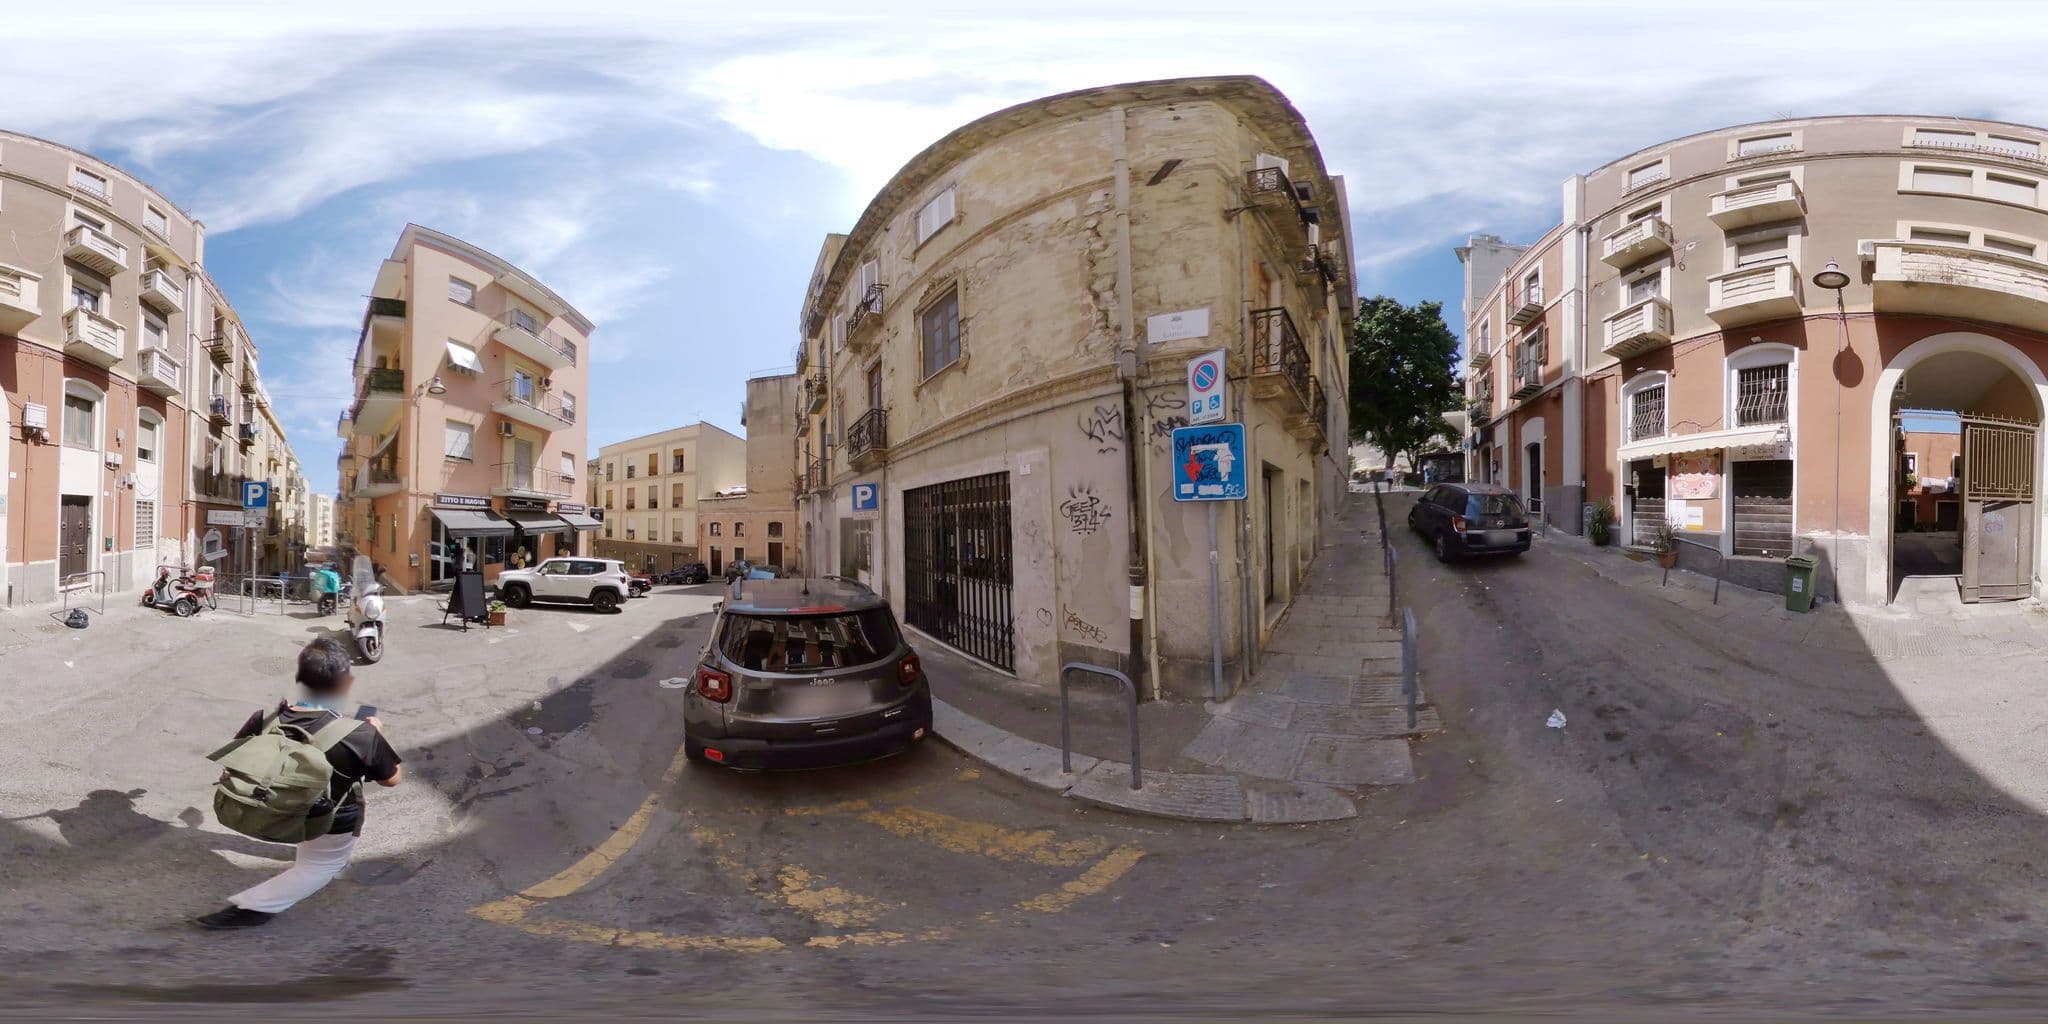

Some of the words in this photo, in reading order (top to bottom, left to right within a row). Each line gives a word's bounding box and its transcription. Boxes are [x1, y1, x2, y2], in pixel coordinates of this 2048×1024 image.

[247, 484, 264, 506] P
[441, 496, 459, 504] ZITTO
[856, 486, 873, 509] P
[809, 678, 835, 688] Jeep
